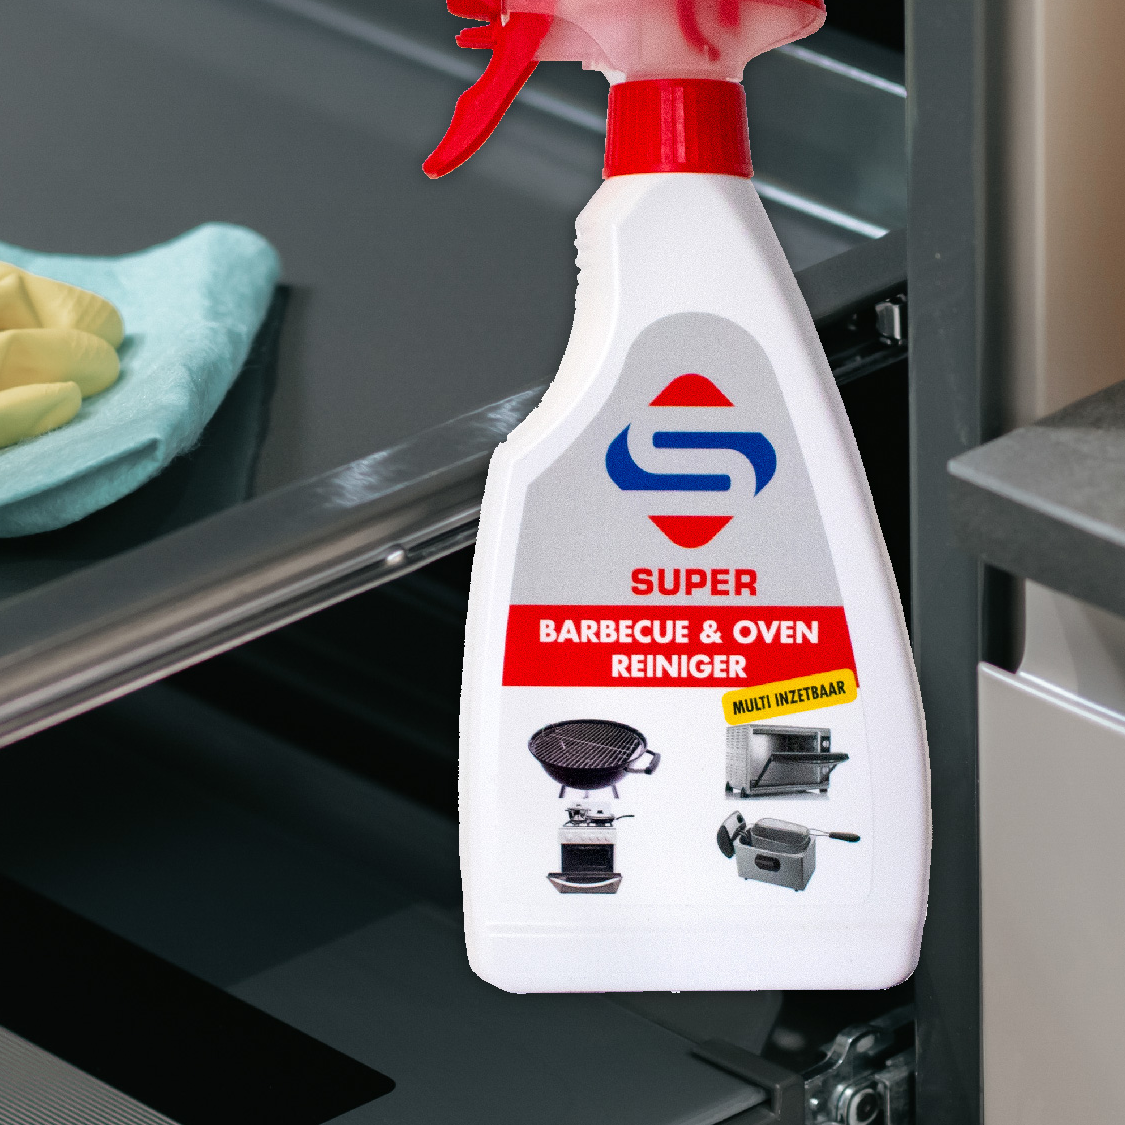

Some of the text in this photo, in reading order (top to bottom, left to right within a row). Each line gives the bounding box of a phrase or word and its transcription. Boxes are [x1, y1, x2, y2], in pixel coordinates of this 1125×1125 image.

[631, 568, 757, 597] SUPER
[539, 619, 819, 644] BARBECUE & OVEN
[611, 655, 748, 679] REINIGER
[732, 681, 846, 715] MULTI INZETBAAR
